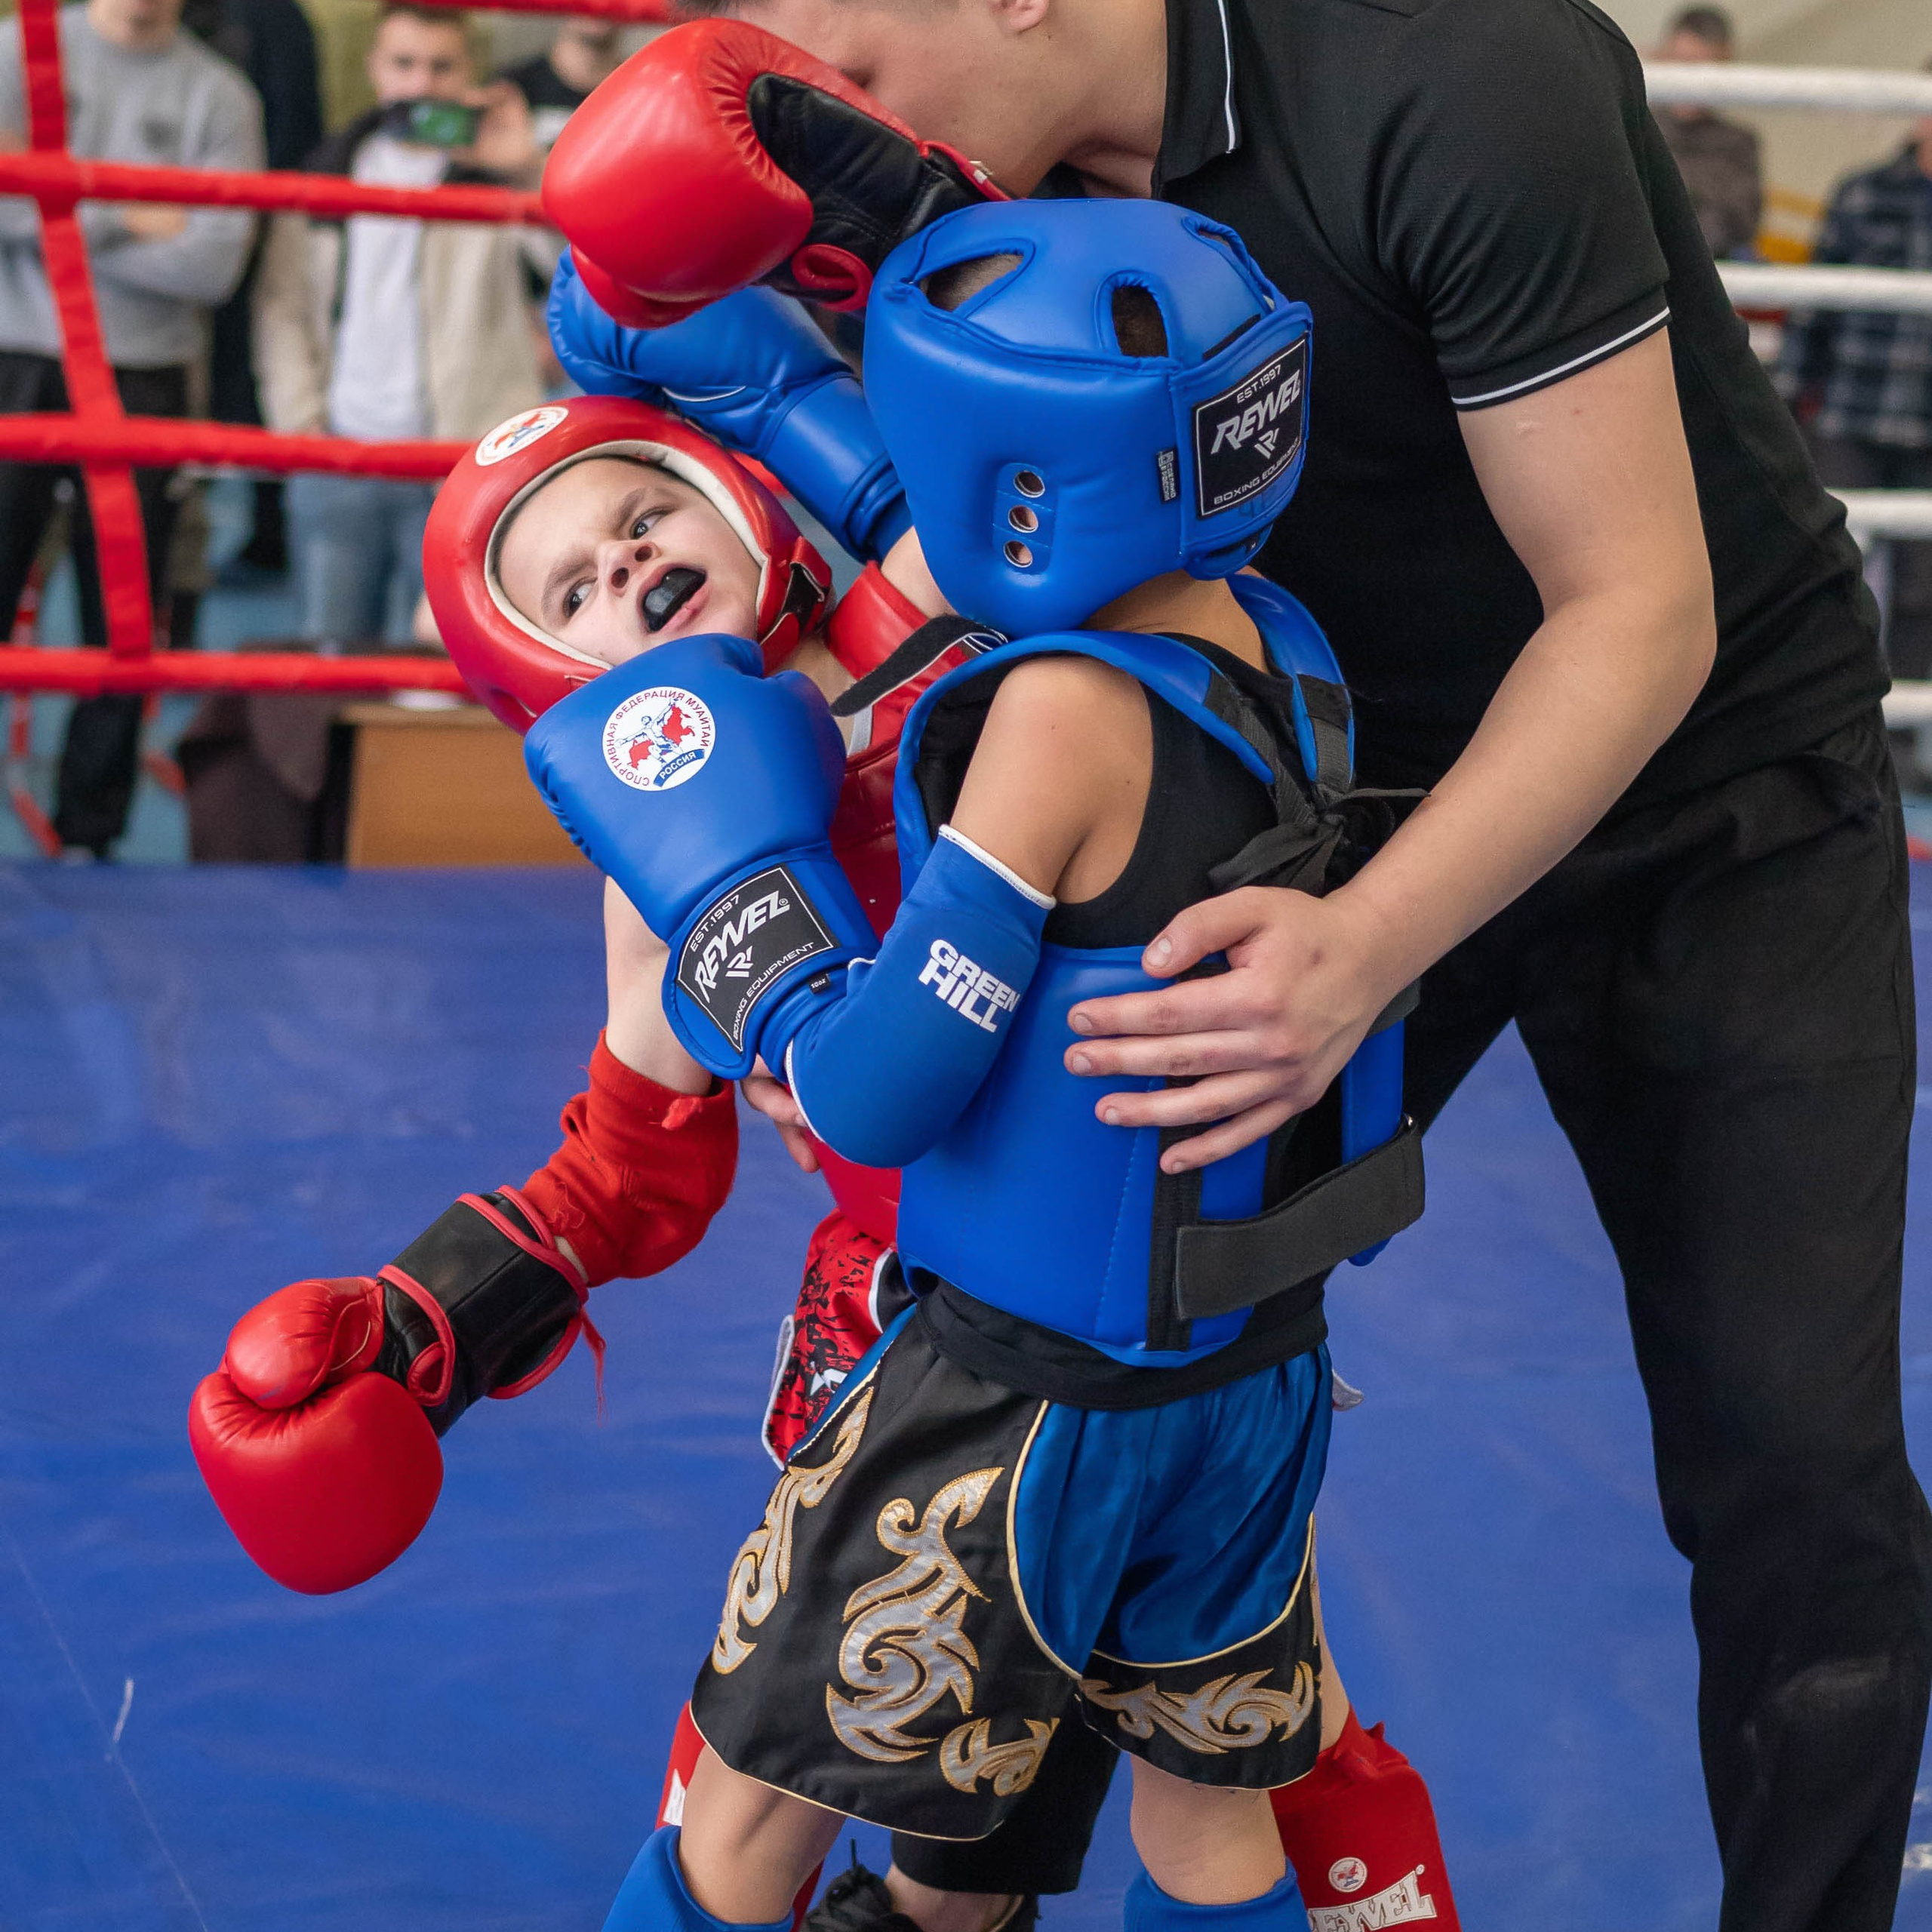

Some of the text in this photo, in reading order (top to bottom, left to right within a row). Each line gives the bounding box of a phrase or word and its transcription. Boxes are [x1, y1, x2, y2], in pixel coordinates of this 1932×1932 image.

[1236, 364, 1281, 404] EST.1997
[1214, 477, 1260, 506] BOXING
[606, 690, 712, 787] СПОРТИВНАЯ ФЕДЕРАЦИЯ МУАЙТАЙ
[659, 751, 697, 780] РОССИЯ
[690, 894, 740, 952] EST.1997
[733, 941, 814, 1041] BOXING EQUIPMENT
[918, 957, 998, 1033] HILL
[930, 939, 1020, 1013] GREEN
[1306, 1870, 1437, 1932] EYVEL
